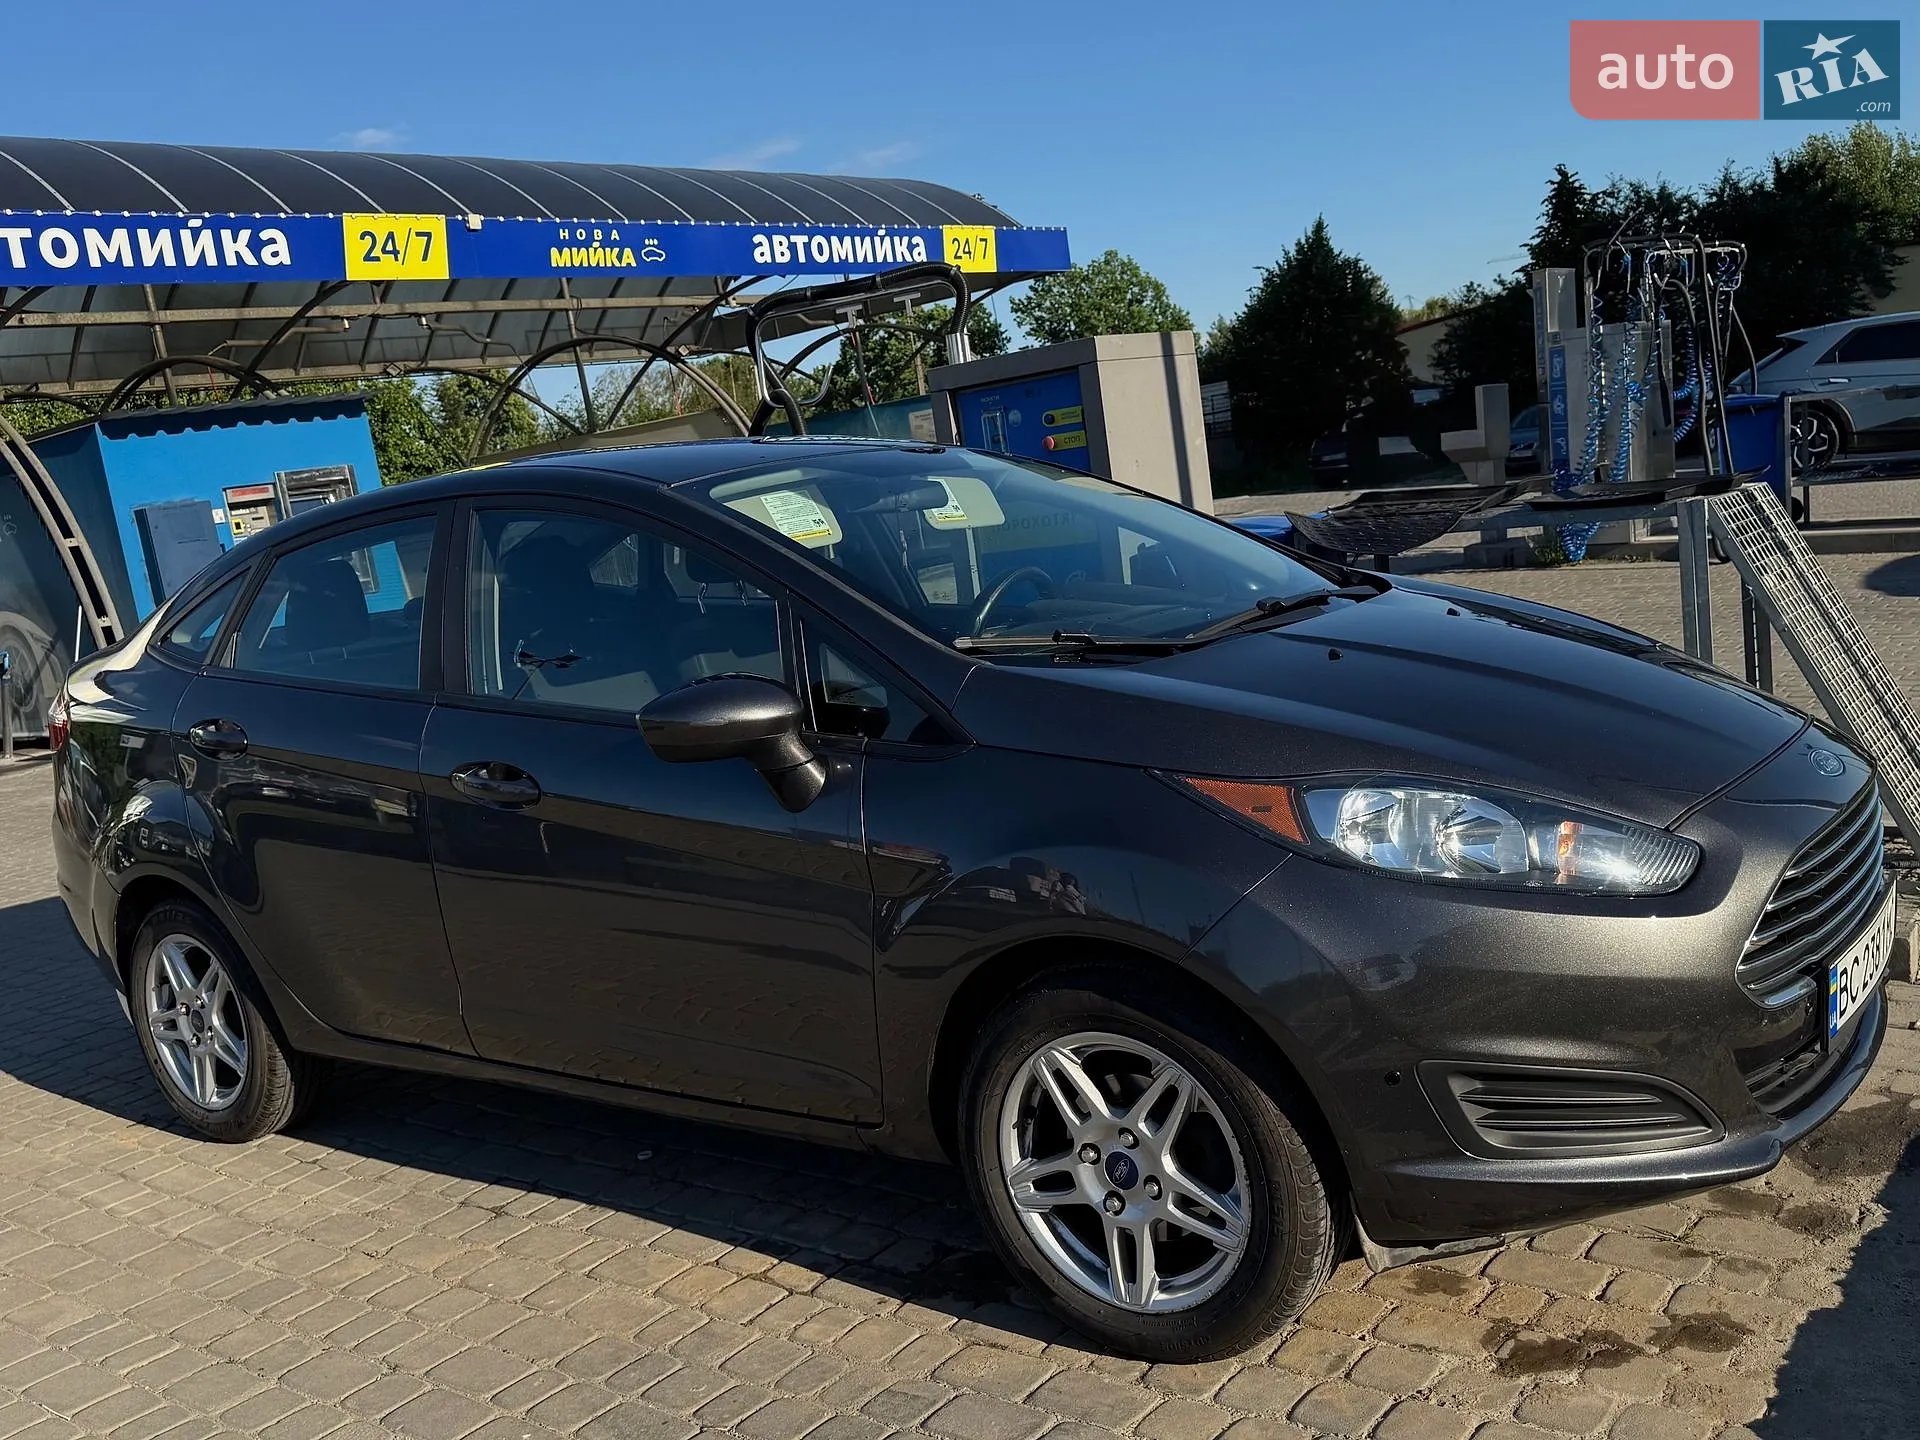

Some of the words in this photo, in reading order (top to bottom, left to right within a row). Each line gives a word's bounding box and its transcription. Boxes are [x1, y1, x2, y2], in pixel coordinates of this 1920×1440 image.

[360, 228, 434, 266] 24/7
[559, 228, 620, 240] НОВА
[752, 229, 928, 264] автомийка
[951, 236, 988, 262] 24/7
[550, 241, 637, 267] МИЙКА
[1839, 956, 1860, 1018] BC
